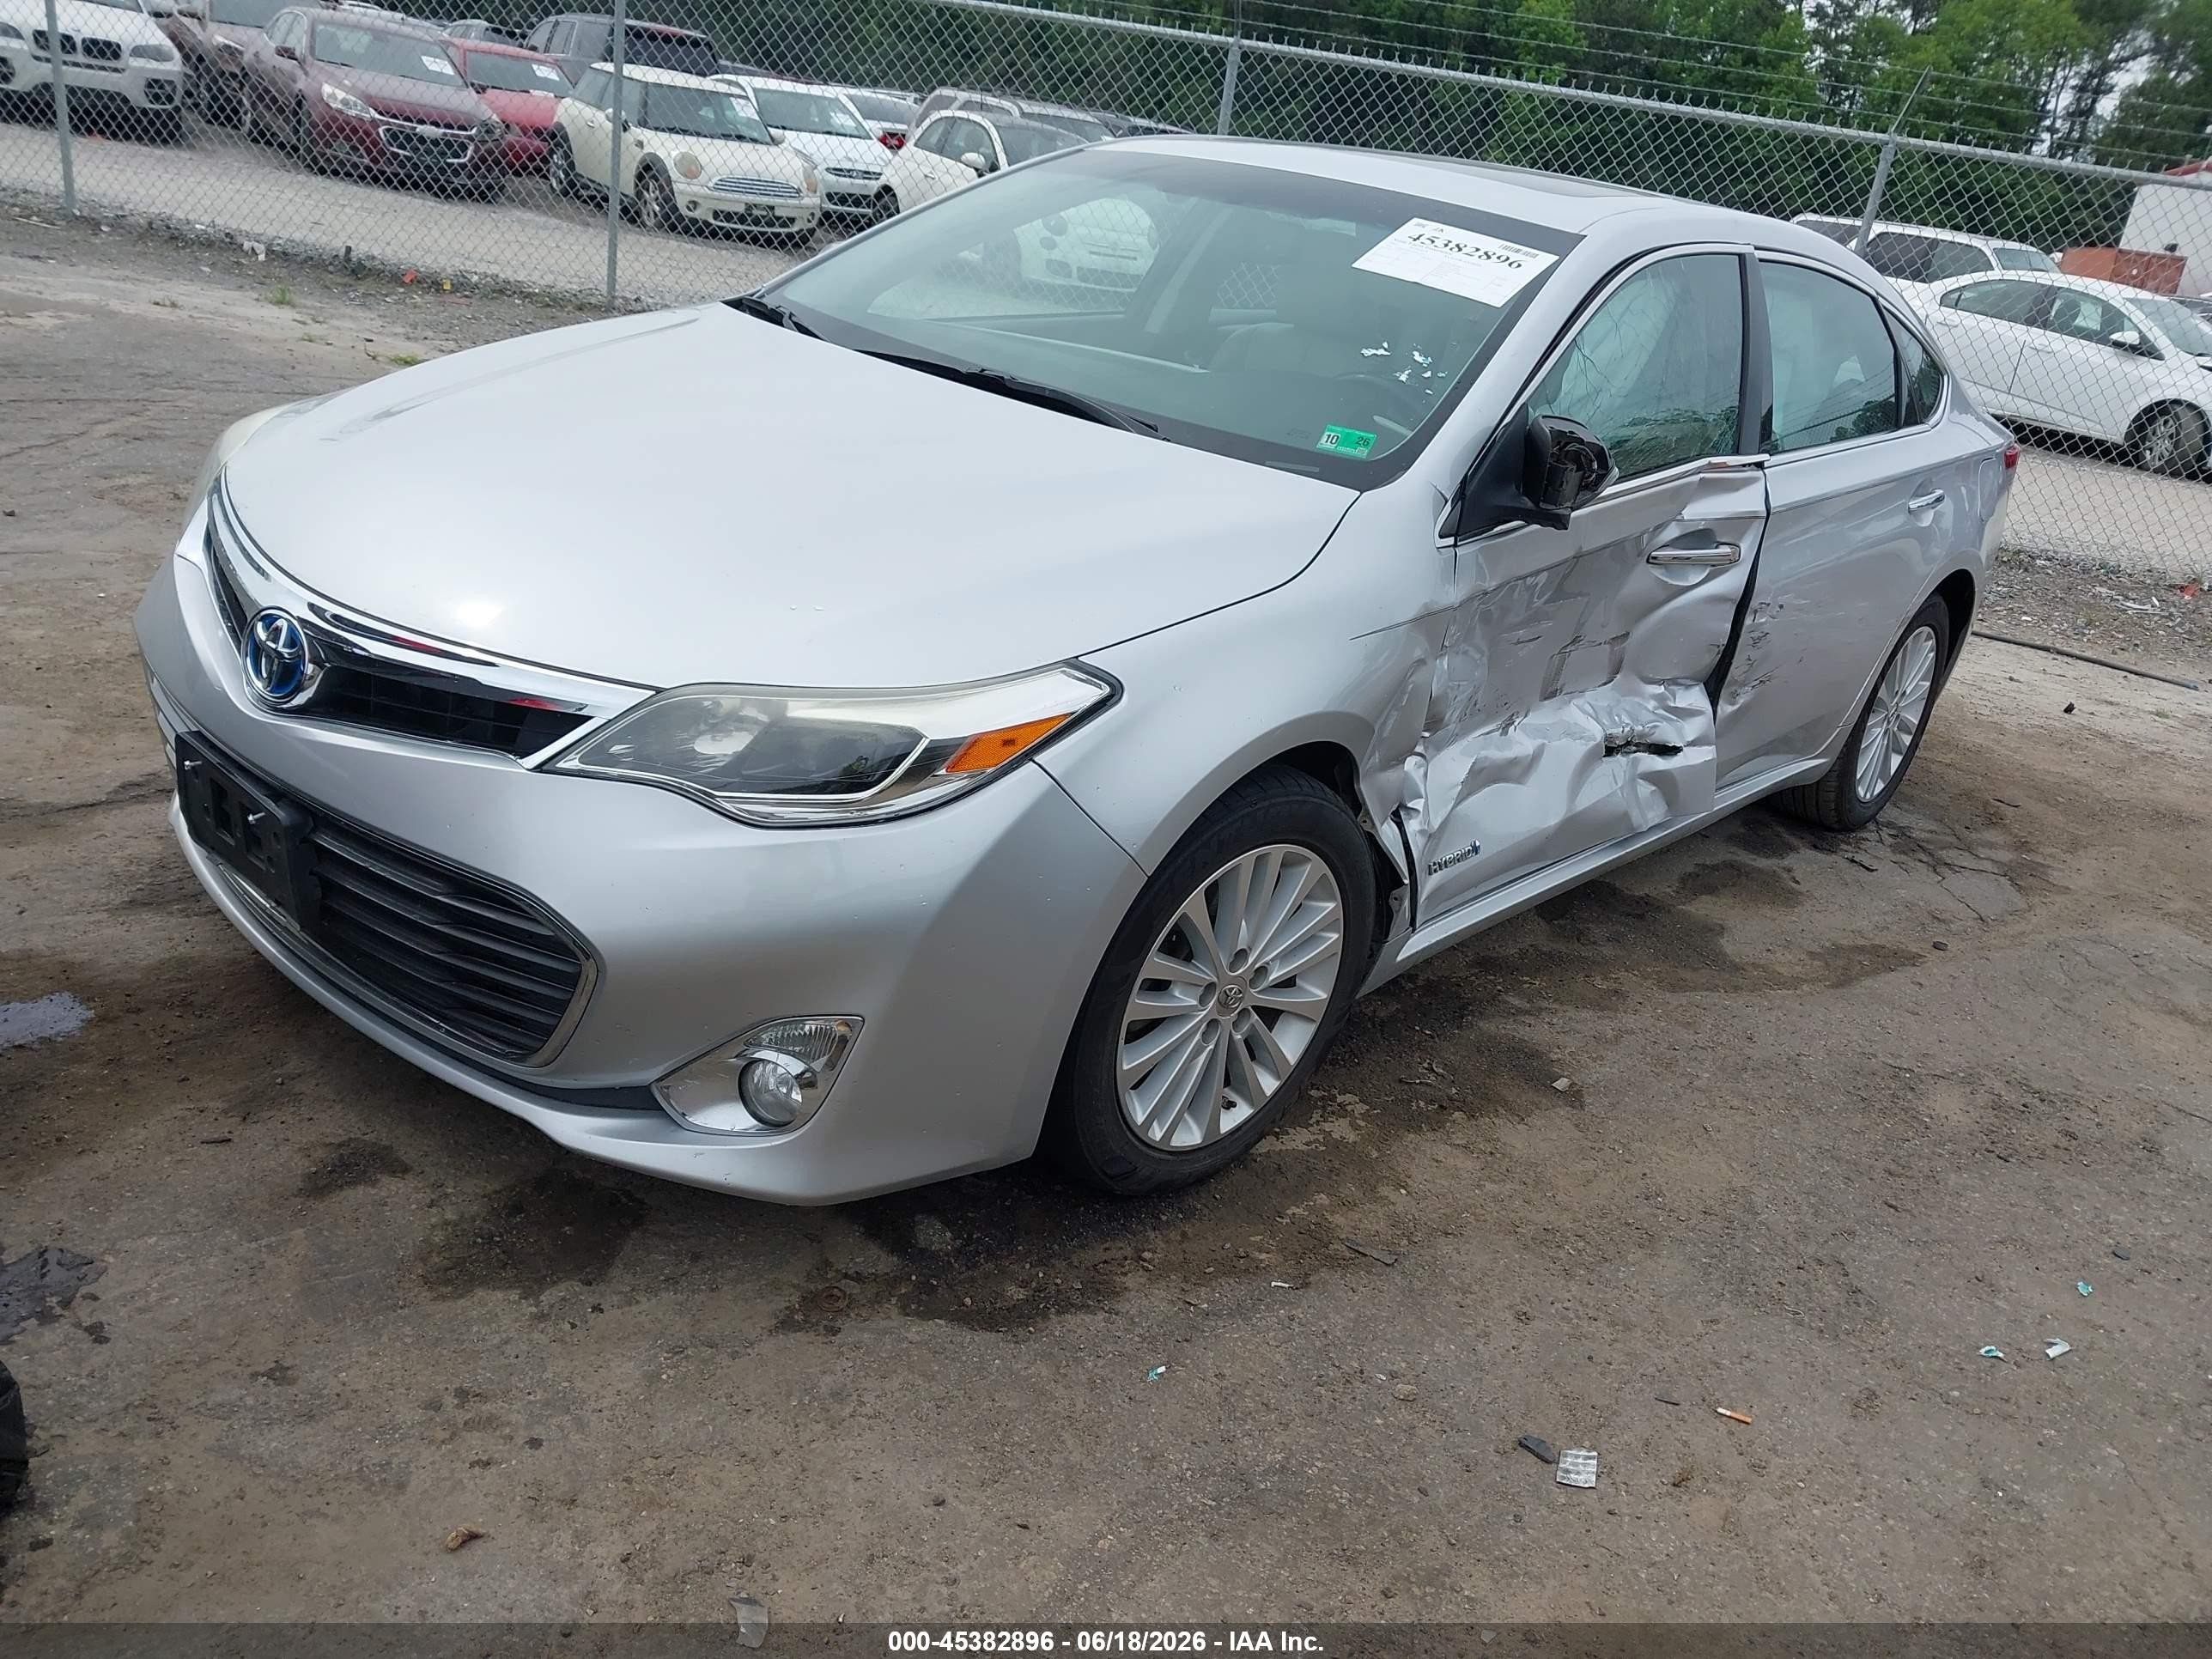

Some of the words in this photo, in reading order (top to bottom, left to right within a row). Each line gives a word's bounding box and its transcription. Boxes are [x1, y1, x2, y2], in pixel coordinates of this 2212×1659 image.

[1407, 233, 1522, 270] 45382896
[1325, 434, 1340, 445] 10
[1356, 436, 1370, 447] 26
